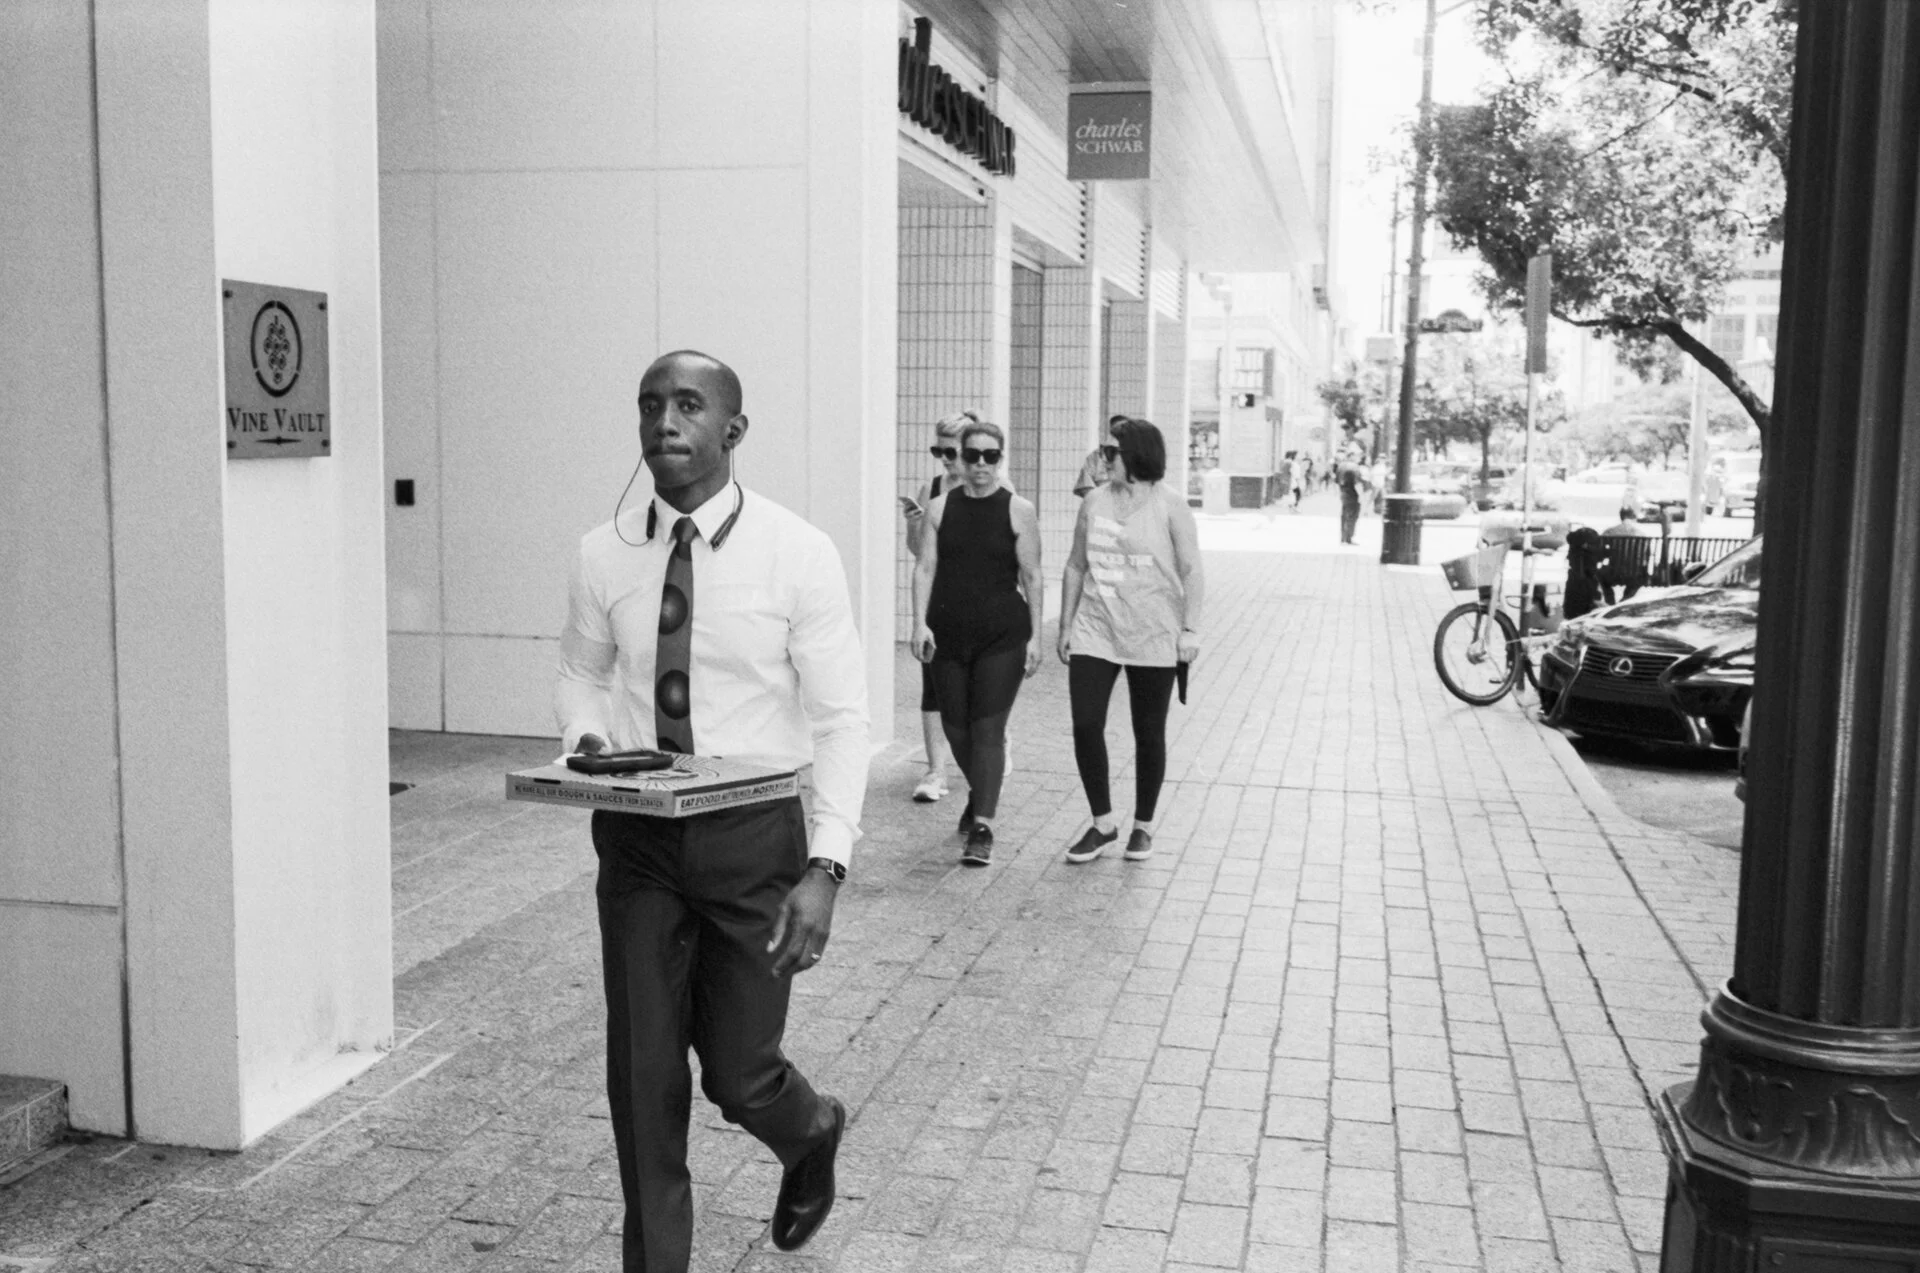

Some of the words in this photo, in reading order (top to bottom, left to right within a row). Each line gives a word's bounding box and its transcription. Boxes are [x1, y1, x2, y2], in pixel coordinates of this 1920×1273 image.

[1075, 117, 1143, 138] charles
[1075, 140, 1145, 154] SCHWAB
[227, 407, 269, 432] VINE
[273, 408, 325, 432] VAULT
[558, 789, 585, 800] DOUGH
[681, 798, 695, 808] EAT
